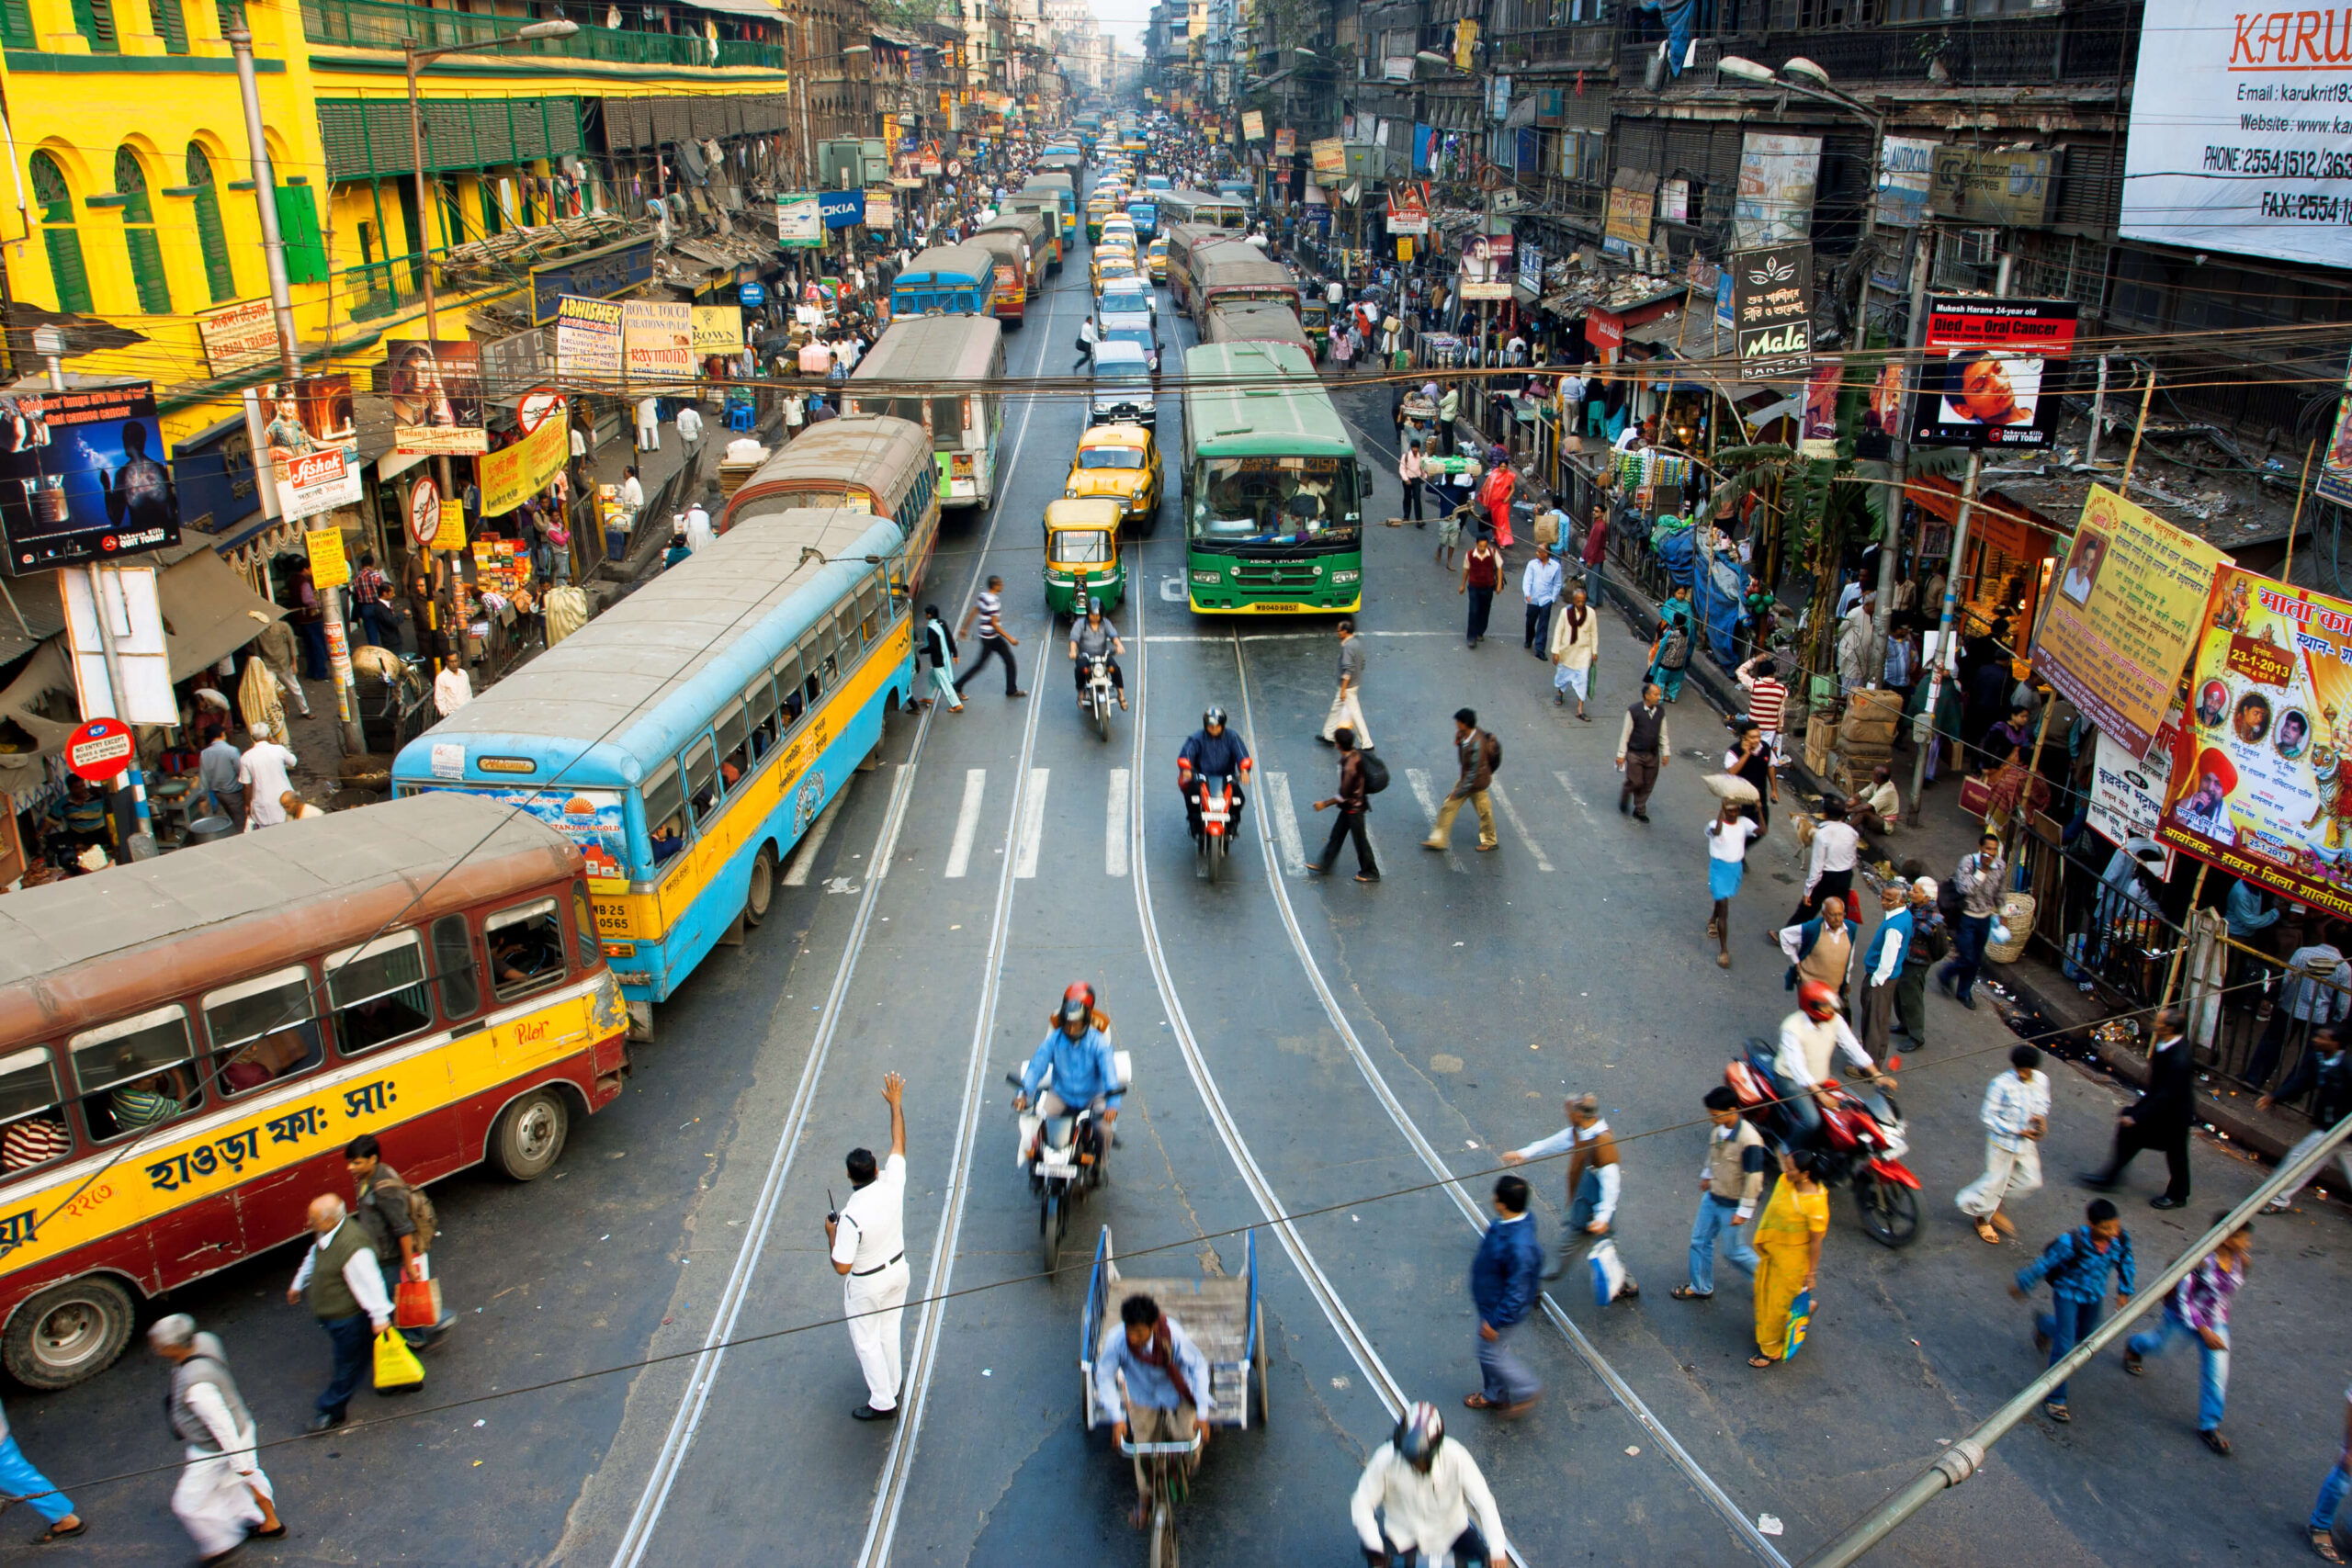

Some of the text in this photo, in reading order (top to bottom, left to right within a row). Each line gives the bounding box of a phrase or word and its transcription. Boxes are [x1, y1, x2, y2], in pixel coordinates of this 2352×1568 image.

[559, 297, 623, 324] ABHISHEK
[626, 303, 689, 319] ROYAL TOUCH
[1936, 303, 2037, 317] Mukesh Harane 24-year old
[559, 316, 618, 333] SHERWANI
[626, 319, 665, 330] CREATIONS
[1933, 318, 1962, 332] Died
[1984, 319, 2011, 333] Oral
[2012, 321, 2058, 336] Cancer
[561, 337, 593, 348] EXCLUSIVE
[577, 332, 597, 340] HOUSE
[1746, 325, 1807, 359] Mala
[560, 344, 579, 354] DHOTI
[630, 347, 688, 367] Raymond
[579, 356, 598, 366] PARTY
[599, 359, 618, 368] DRESS
[46, 406, 130, 426] that causes cancer
[397, 428, 427, 440] Madanji
[292, 455, 342, 484] Ashok
[1306, 457, 1338, 473] 215A
[119, 534, 164, 548] QUIT TODAY
[2257, 583, 2352, 637] माता का
[2296, 631, 2337, 660] स्थान-
[2230, 648, 2291, 679] 23-1-2013
[85, 741, 103, 750] ENTRY
[104, 736, 125, 746] EXCEPT
[550, 823, 621, 832] TANJALI GOLD
[2256, 829, 2288, 848] भण्डारा-
[2164, 826, 2216, 857] आयोजक-
[2221, 851, 2257, 876] हावड़ा
[2260, 866, 2296, 891] जिला
[2248, 839, 2290, 861] 25-1-2013
[144, 1126, 261, 1193] হাওড়া
